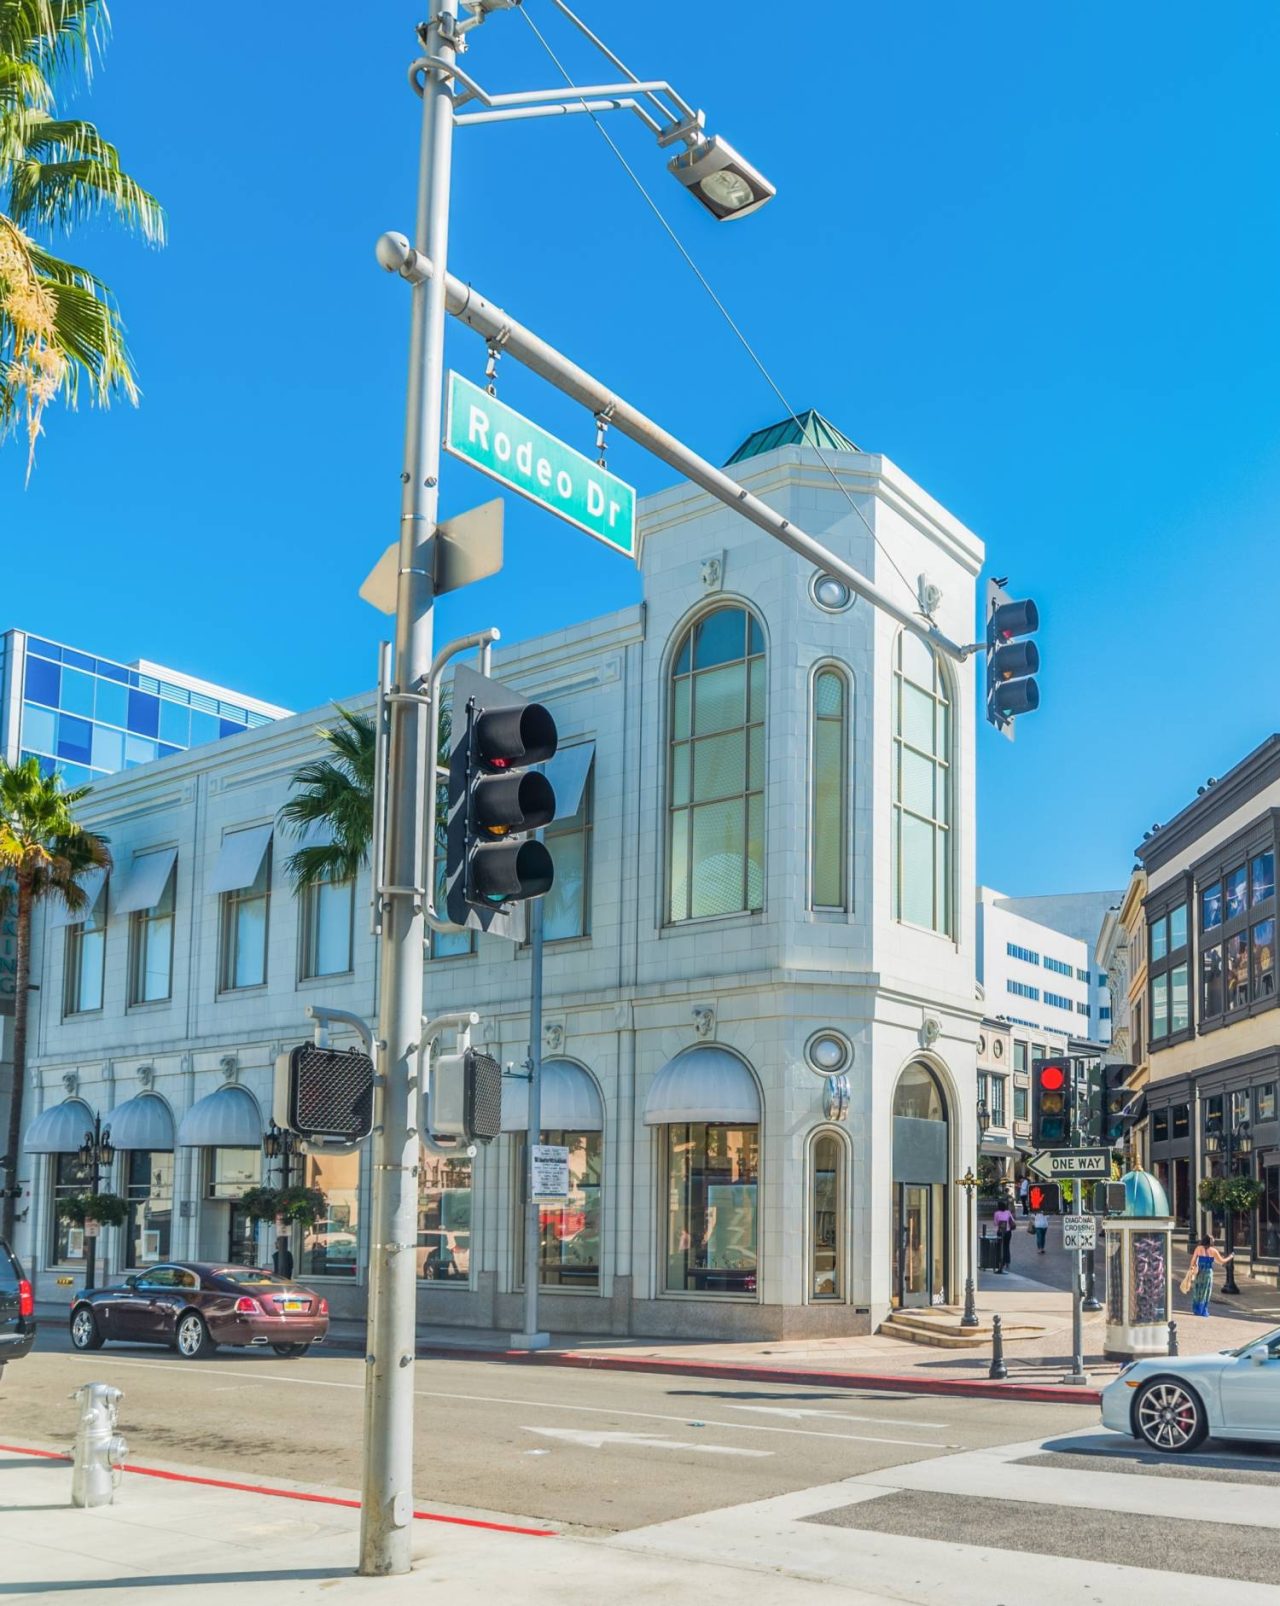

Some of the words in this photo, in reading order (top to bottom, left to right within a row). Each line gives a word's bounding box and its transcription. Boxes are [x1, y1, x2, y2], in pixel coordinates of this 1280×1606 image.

[469, 405, 573, 499] Rodeo
[587, 479, 620, 527] Dr
[1052, 1158, 1075, 1169] ONE
[1077, 1158, 1101, 1169] WAY
[1065, 1235, 1077, 1246] OK
